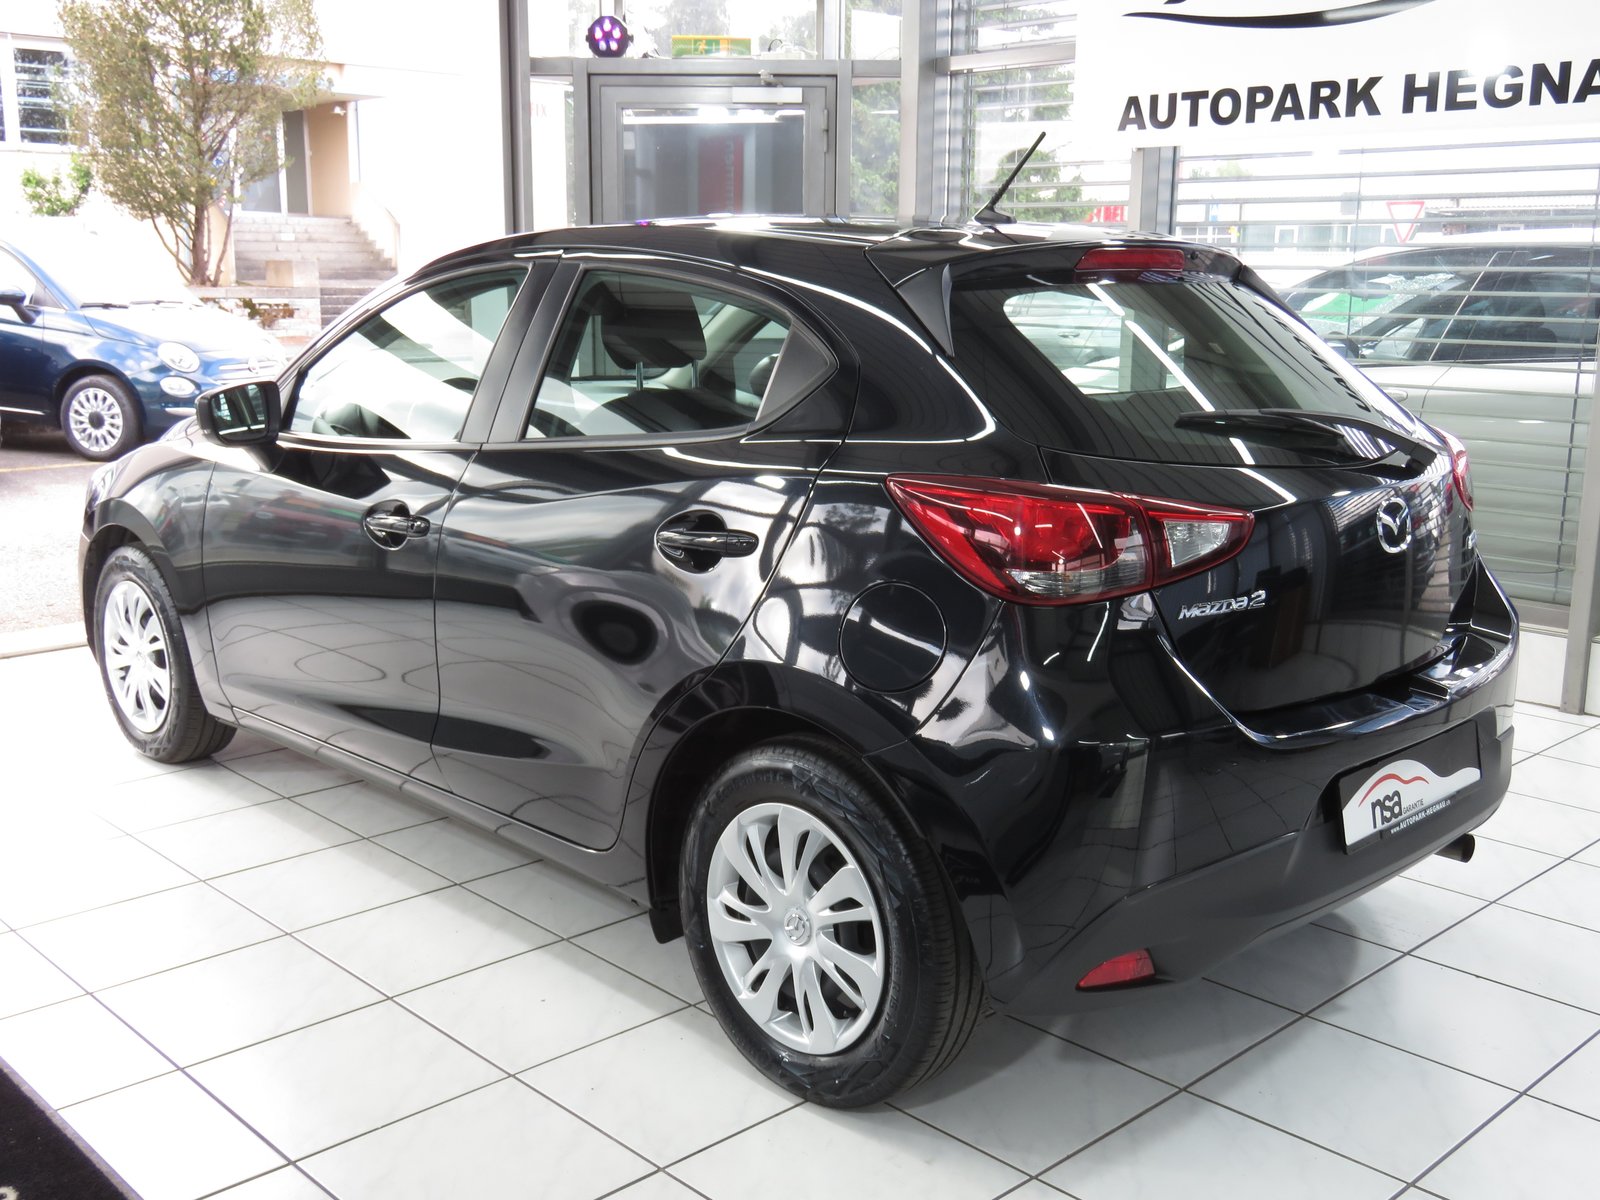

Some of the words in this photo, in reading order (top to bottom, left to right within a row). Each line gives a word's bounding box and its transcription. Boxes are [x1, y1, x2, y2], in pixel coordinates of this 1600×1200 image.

[1117, 76, 1383, 132] AUTOPARK
[1370, 790, 1402, 829] nsa
[1403, 798, 1424, 815] GARANTIE
